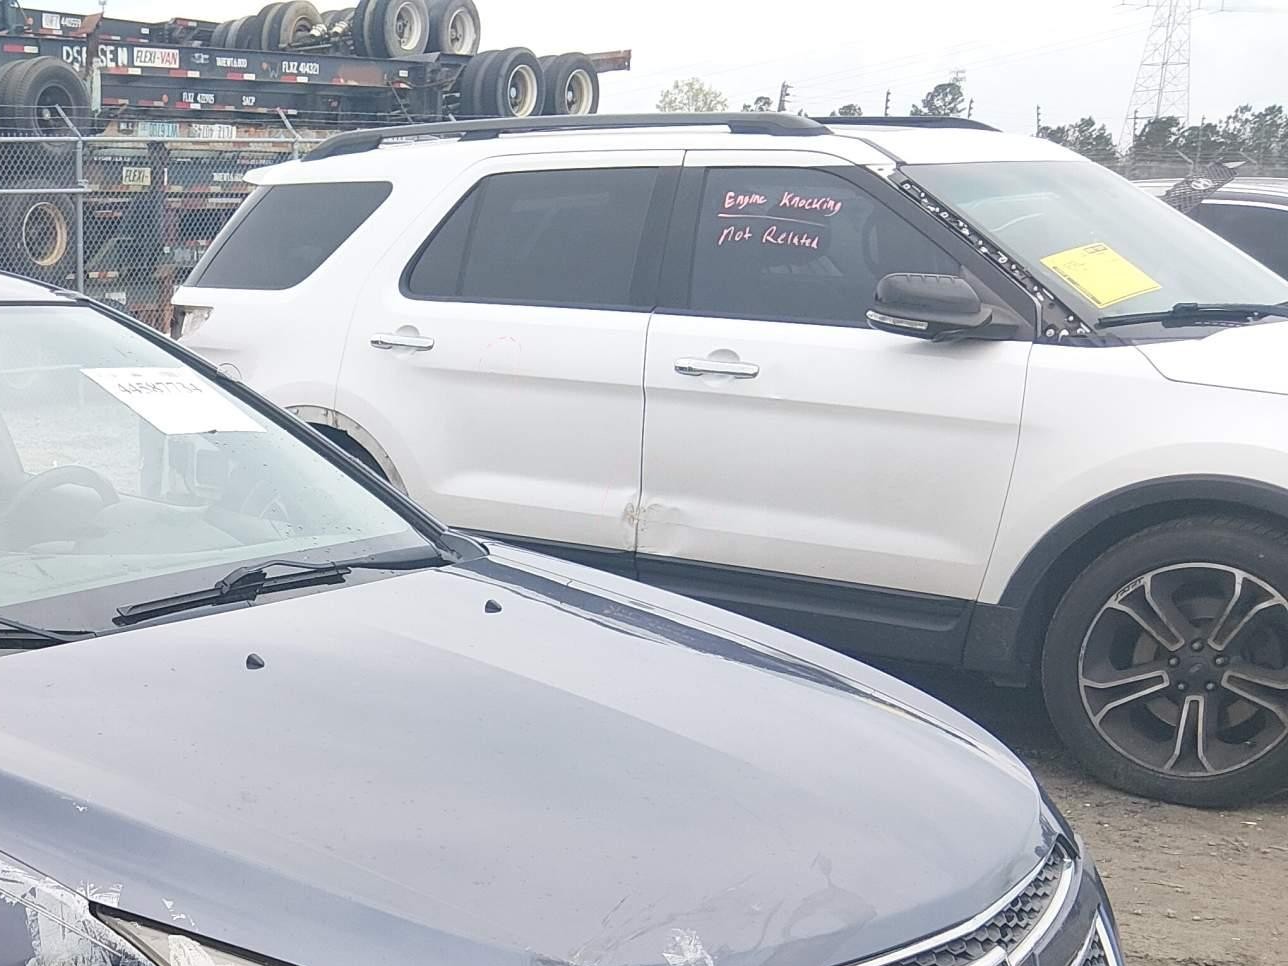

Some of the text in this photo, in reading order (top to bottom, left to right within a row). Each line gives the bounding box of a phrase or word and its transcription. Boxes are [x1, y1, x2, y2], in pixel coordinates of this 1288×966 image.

[135, 50, 178, 66] FLEXI-VAN
[724, 191, 842, 217] Engine Knocking
[761, 226, 818, 249] Related
